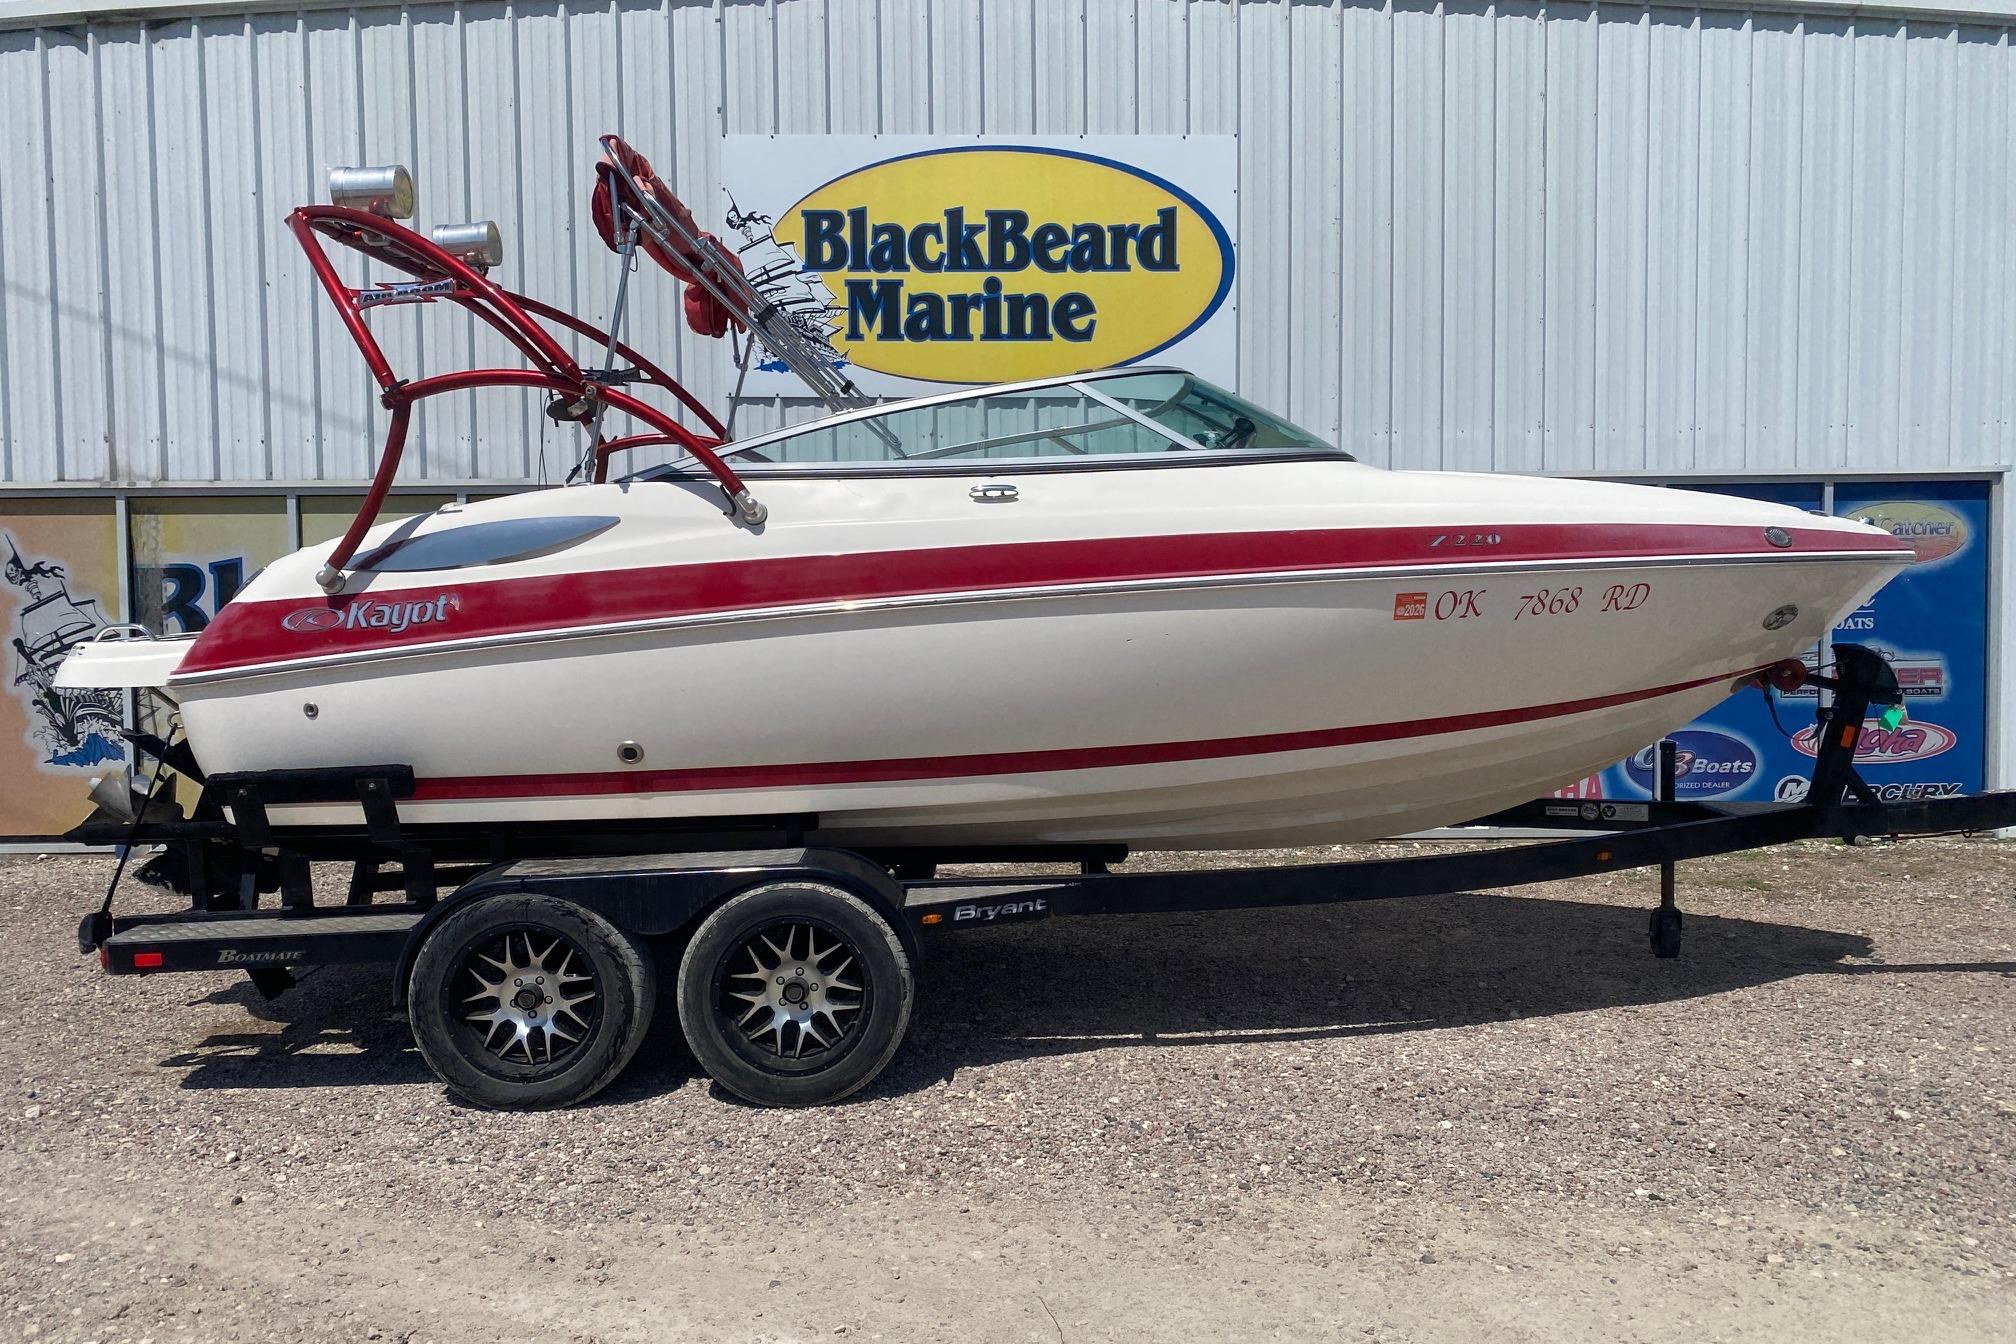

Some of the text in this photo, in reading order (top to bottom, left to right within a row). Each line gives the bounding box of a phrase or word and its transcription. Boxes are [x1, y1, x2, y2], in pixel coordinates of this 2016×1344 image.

[801, 205, 1180, 273] BlackBeard
[844, 276, 1098, 342] Marine
[346, 592, 448, 633] Kayot
[1404, 604, 1425, 616] 2026
[1434, 582, 1651, 620] OK 7868 RD
[1692, 758, 1753, 774] Boats
[1702, 781, 1731, 789] DEALER
[953, 898, 1047, 920] Bryant
